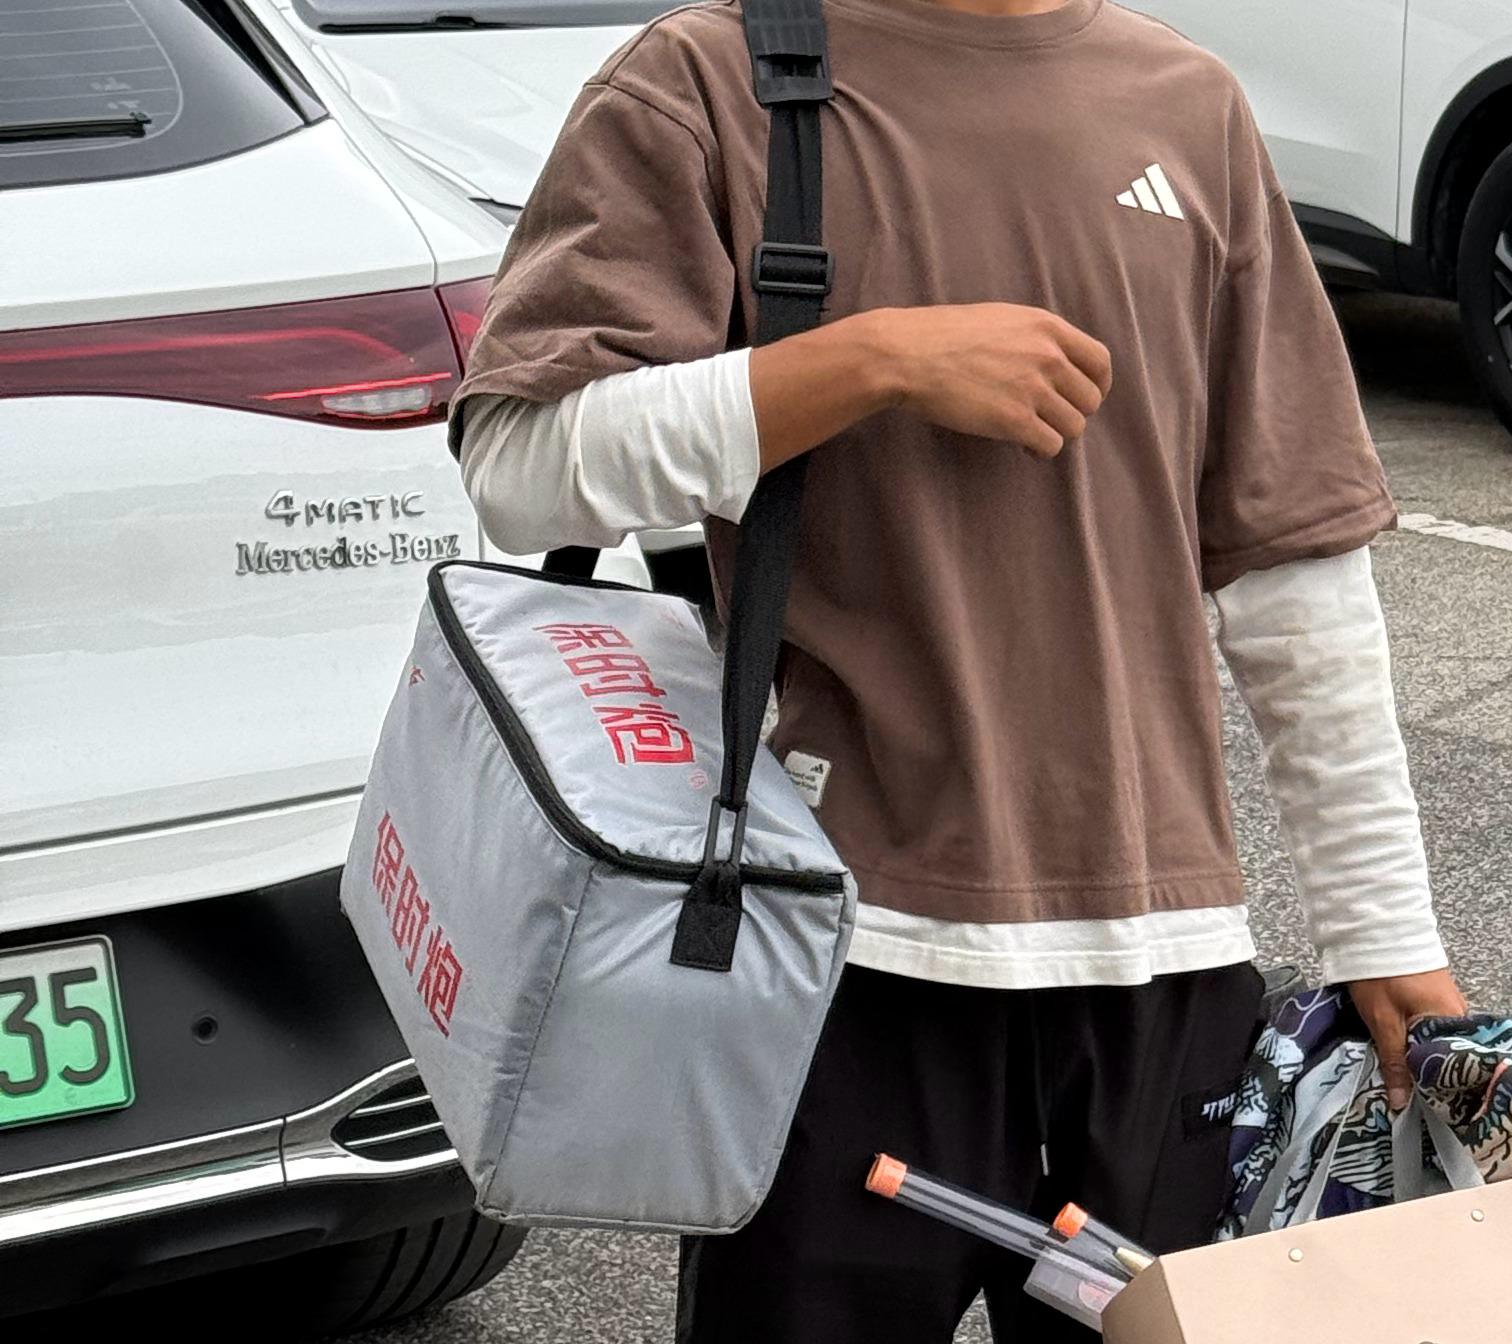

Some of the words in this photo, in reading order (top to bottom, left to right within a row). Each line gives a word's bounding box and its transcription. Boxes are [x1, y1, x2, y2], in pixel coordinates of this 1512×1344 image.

[264, 489, 425, 527] 4MATIC
[235, 532, 461, 576] Mercedes-Benz
[0, 966, 110, 1098] 35
